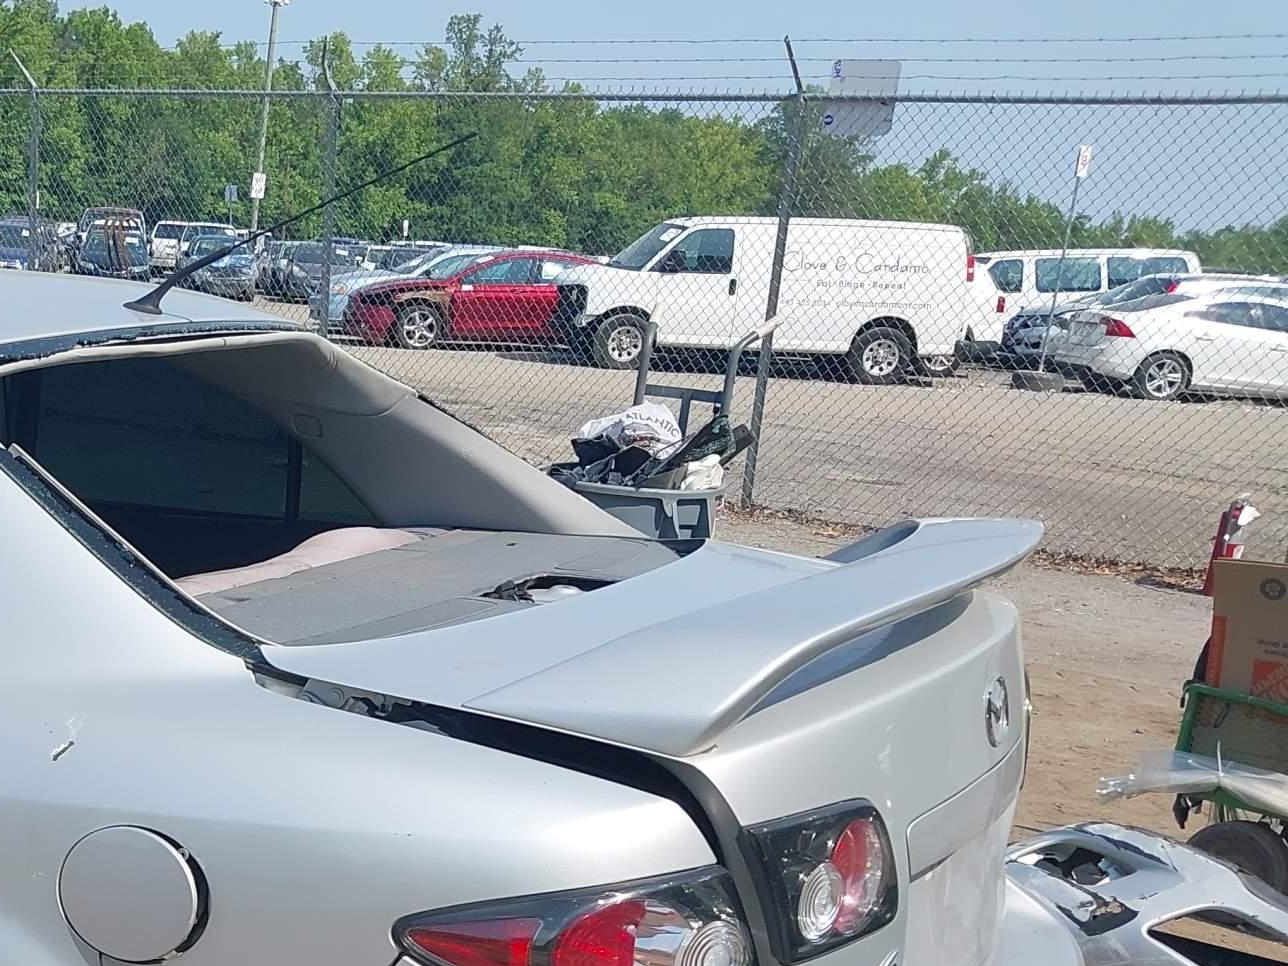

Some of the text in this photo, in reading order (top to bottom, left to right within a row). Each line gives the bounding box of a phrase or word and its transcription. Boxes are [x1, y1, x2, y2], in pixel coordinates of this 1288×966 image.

[783, 250, 827, 272] Clove
[835, 255, 847, 272] &
[626, 412, 680, 438] ATLANTIC
